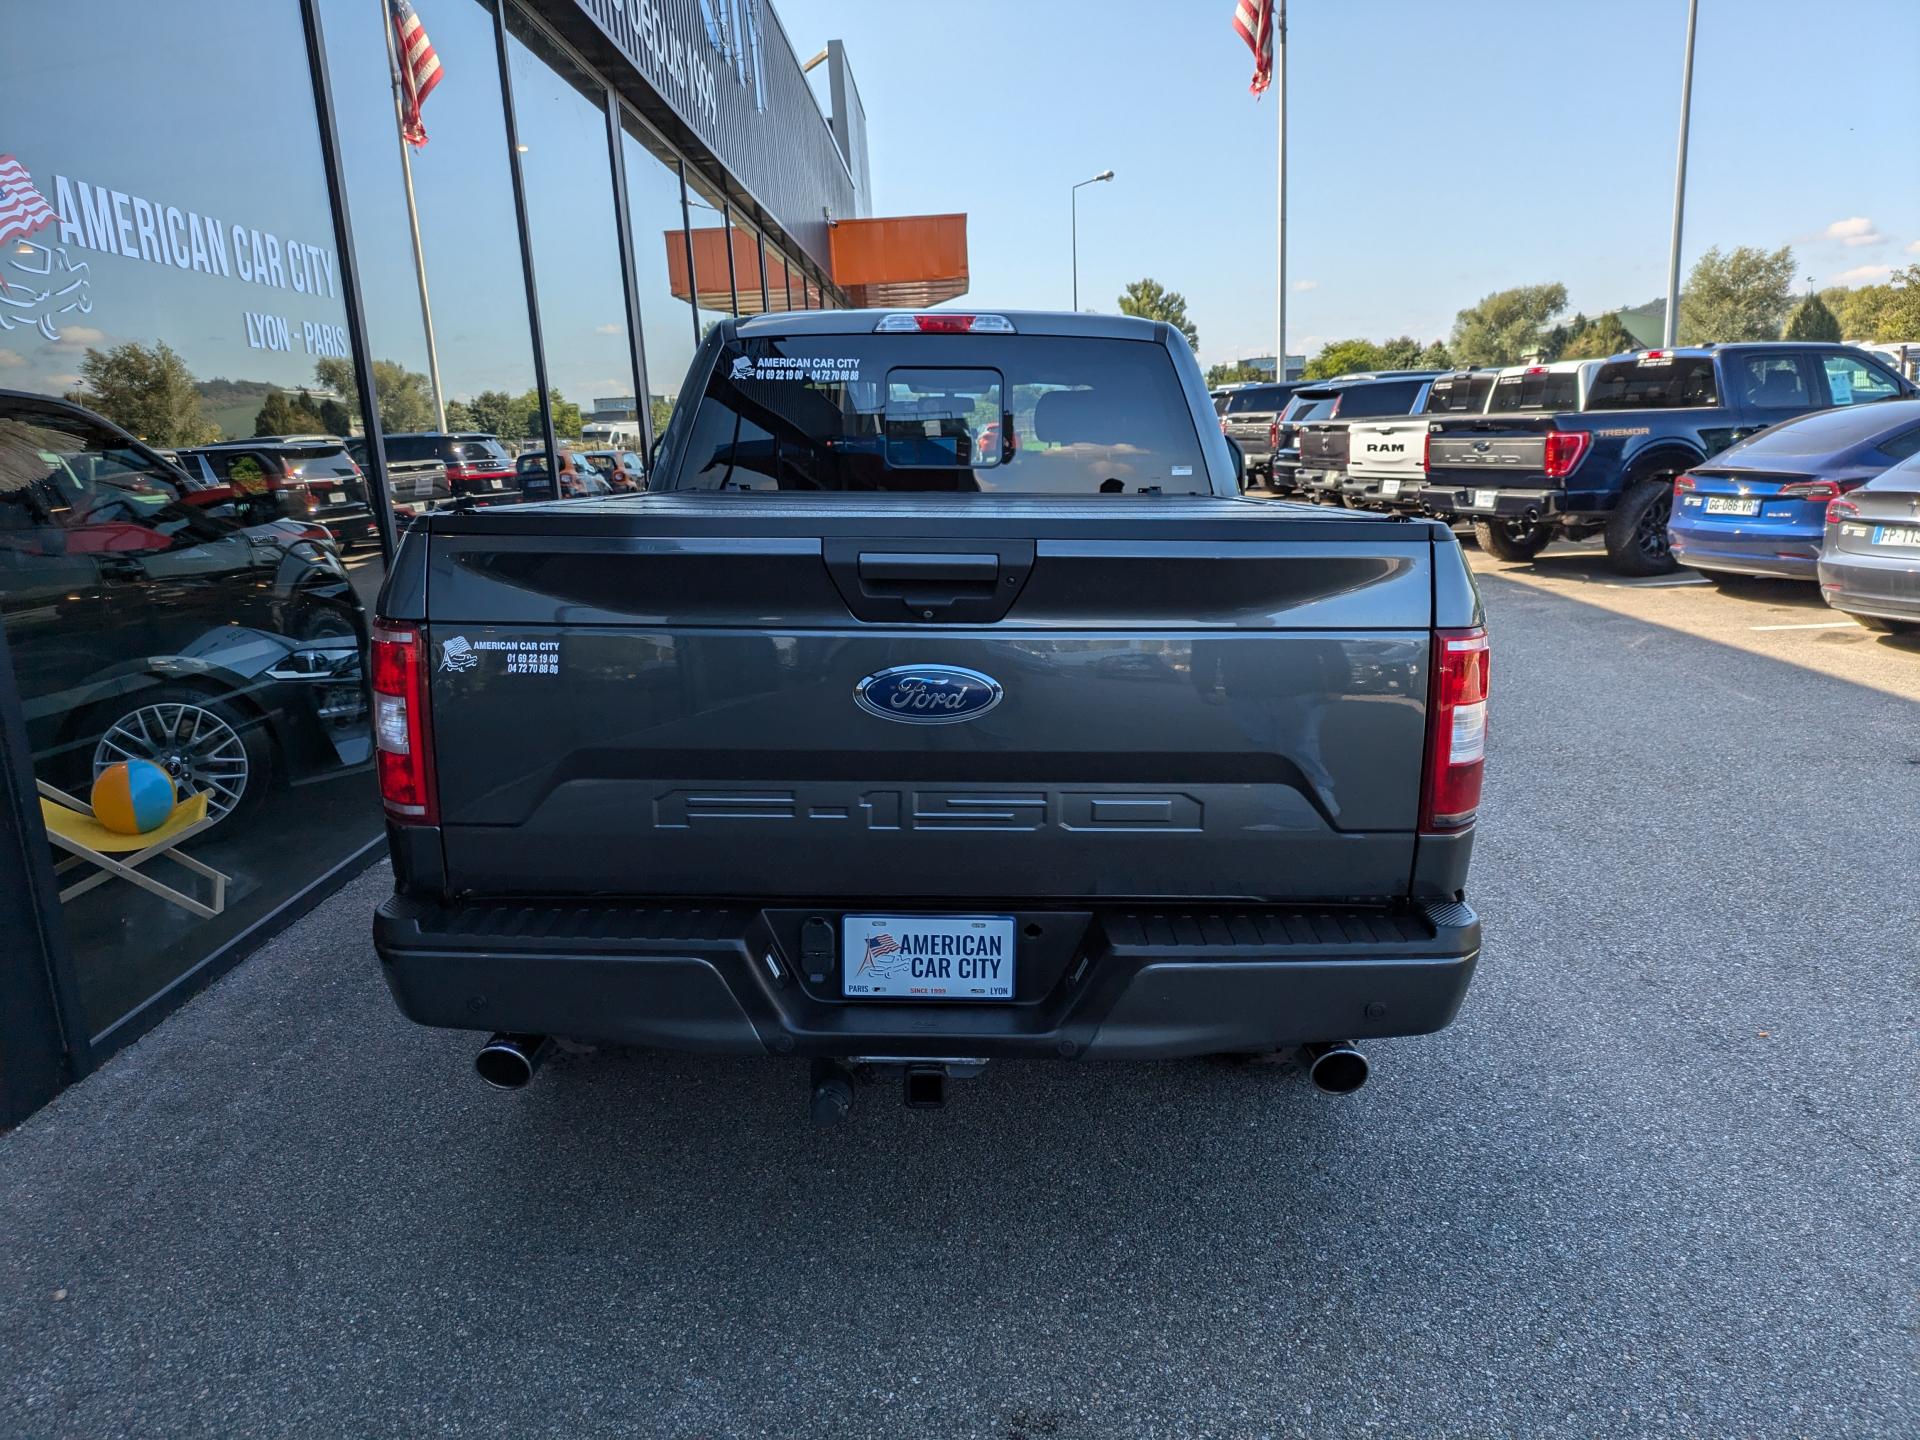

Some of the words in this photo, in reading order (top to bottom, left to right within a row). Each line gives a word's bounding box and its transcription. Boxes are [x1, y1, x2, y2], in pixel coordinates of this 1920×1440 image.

[54, 174, 230, 277] AMERICAN
[231, 224, 286, 288] CAR
[287, 239, 336, 298] CITY
[244, 312, 291, 352] LYON
[302, 321, 348, 358] PARIS
[757, 358, 810, 368] AMERICAN
[813, 358, 834, 368] CAR
[837, 358, 860, 368] CITY
[756, 370, 764, 380] 01
[766, 370, 775, 380] 69
[775, 370, 784, 380] 22
[785, 370, 793, 380] 19
[812, 370, 820, 380] 04
[821, 370, 830, 380] 72
[831, 370, 840, 380] 70
[1597, 427, 1650, 437] TREMOR
[1367, 444, 1404, 452] RAM
[473, 641, 518, 650] AMERICAN
[520, 642, 537, 651] CAR
[540, 642, 560, 651] CITY
[507, 654, 515, 663] 01
[528, 654, 537, 663] 22
[539, 654, 547, 663] 19
[549, 654, 558, 663] 00
[508, 664, 517, 673] 04
[518, 664, 527, 673] 72
[529, 664, 538, 673] 70
[890, 677, 969, 709] Ford
[653, 789, 1205, 832] F-150
[900, 934, 1002, 956] AMERICAN
[911, 957, 951, 978] CAR
[958, 958, 1002, 979] CITY
[848, 985, 869, 993] PARIS
[990, 987, 1008, 995] LYON
